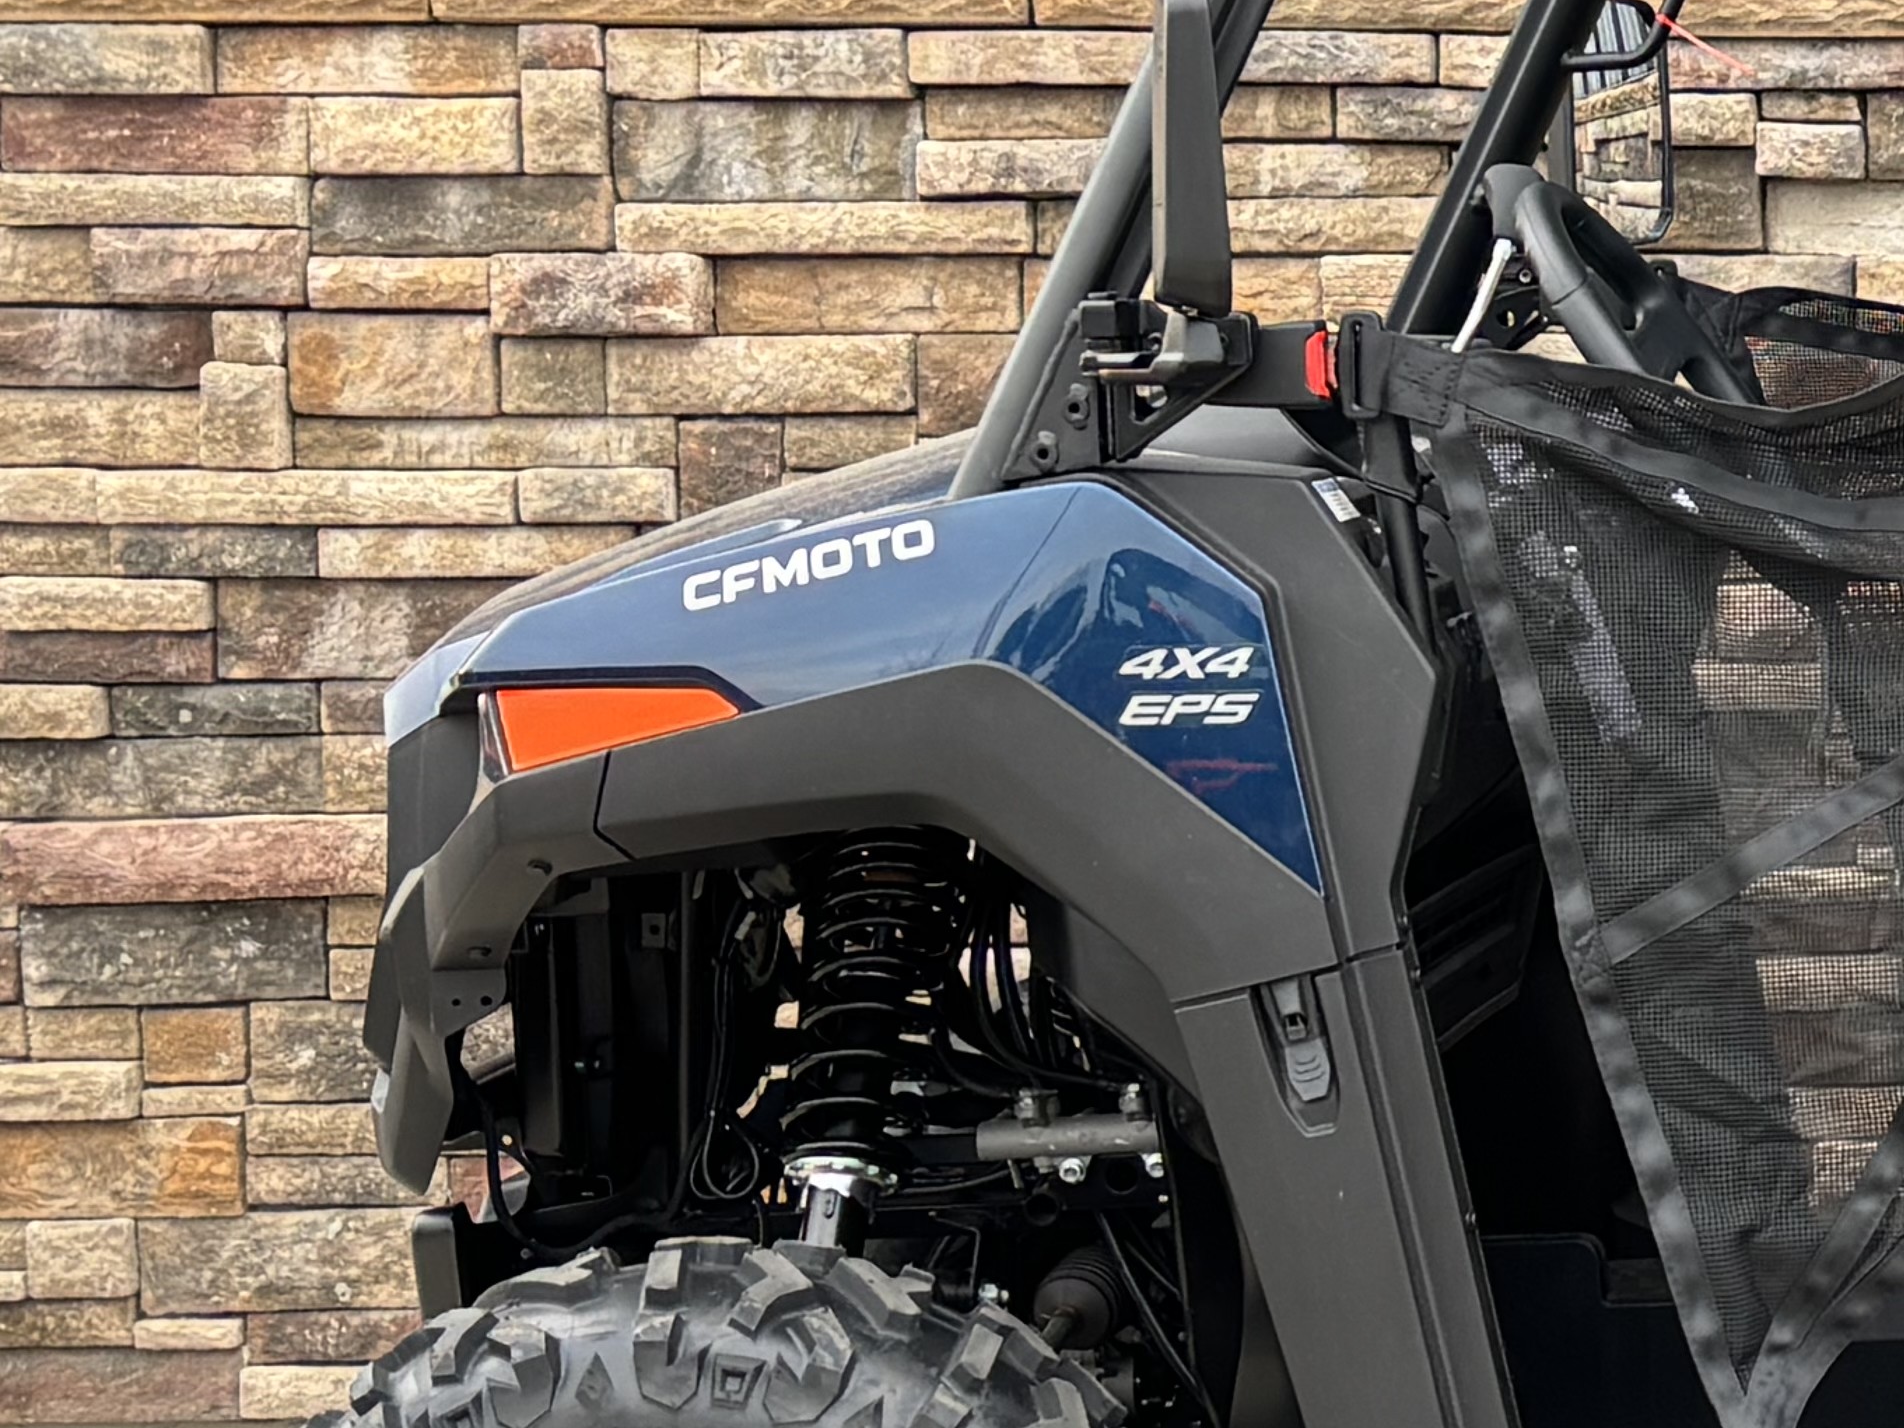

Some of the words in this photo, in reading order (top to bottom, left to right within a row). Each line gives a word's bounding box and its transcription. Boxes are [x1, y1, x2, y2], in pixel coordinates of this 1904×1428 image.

[683, 519, 935, 612] CFMOTO
[1117, 646, 1254, 680] 4X4
[1118, 693, 1260, 726] EPS
